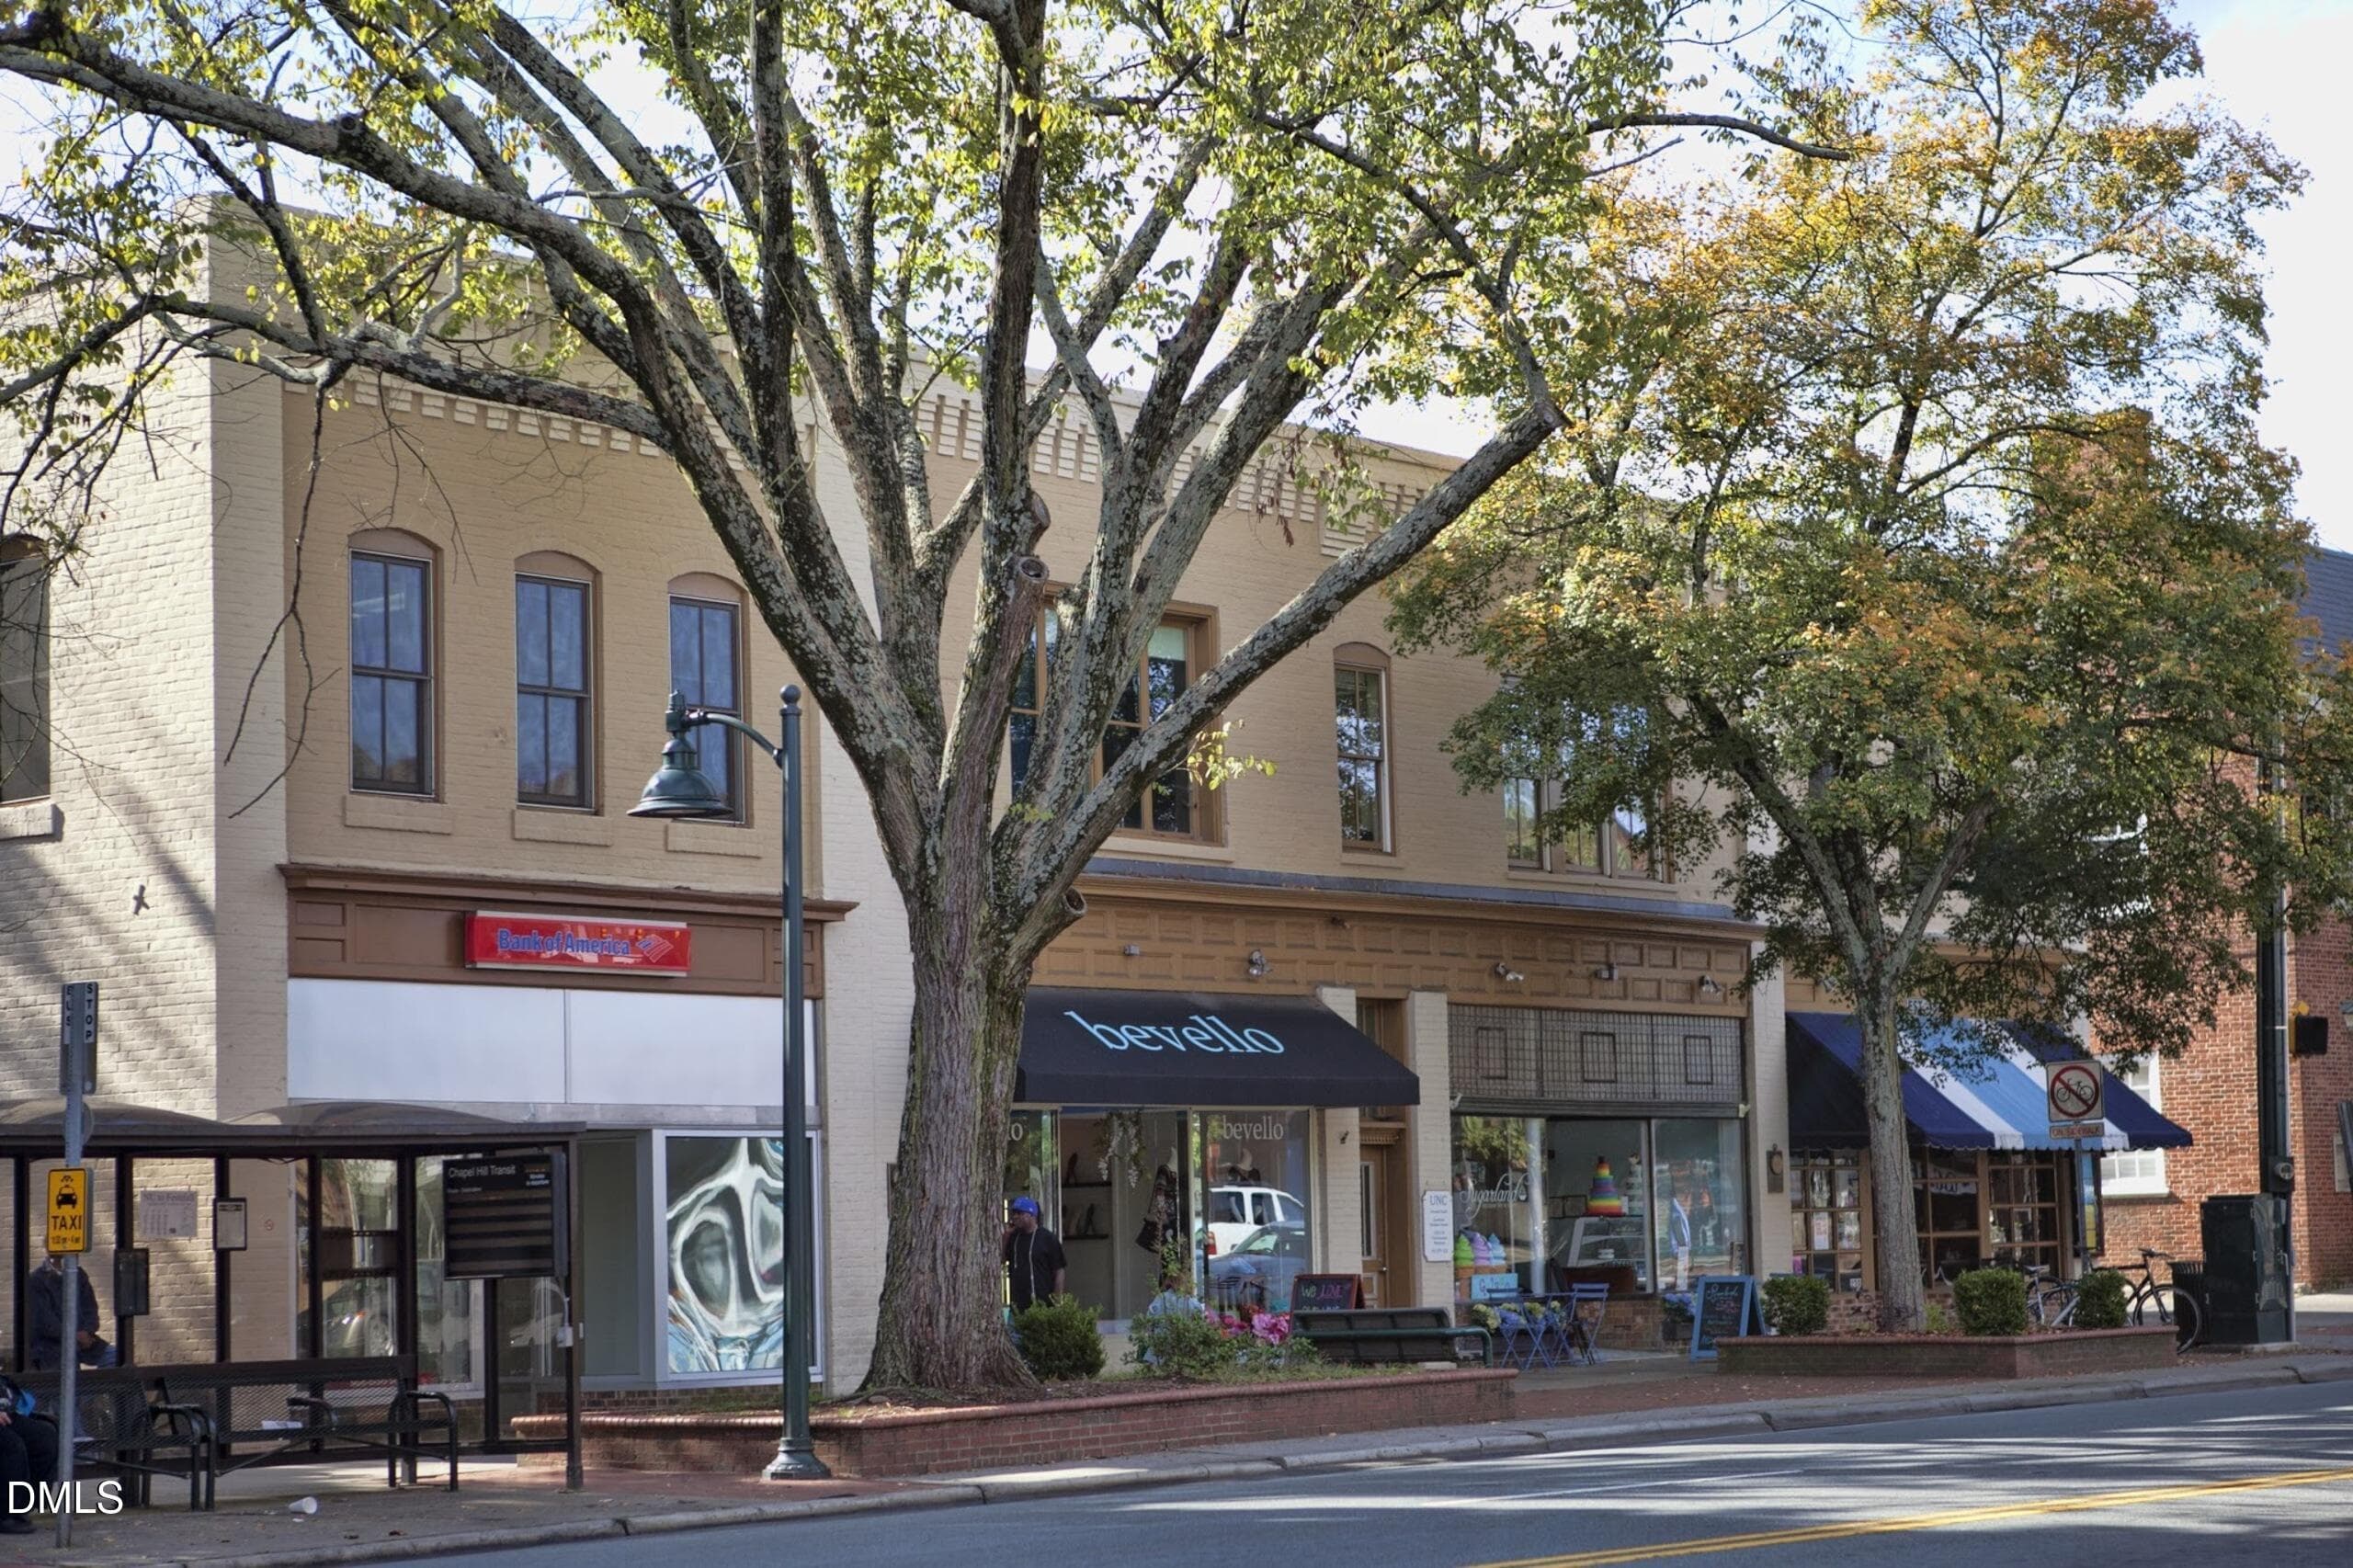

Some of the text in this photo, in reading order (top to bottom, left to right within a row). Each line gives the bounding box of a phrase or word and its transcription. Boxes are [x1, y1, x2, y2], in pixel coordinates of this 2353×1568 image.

[497, 928, 631, 955] Bank of America
[85, 983, 94, 1040] STOP
[1063, 1011, 1285, 1053] bevello
[1222, 1114, 1284, 1140] bevello
[449, 1167, 475, 1179] Chapel
[476, 1165, 489, 1176] Hill
[490, 1165, 516, 1176] Transit
[1429, 1195, 1449, 1206] UNC
[1459, 1173, 1529, 1221] Sugarland
[51, 1215, 82, 1230] TAXI
